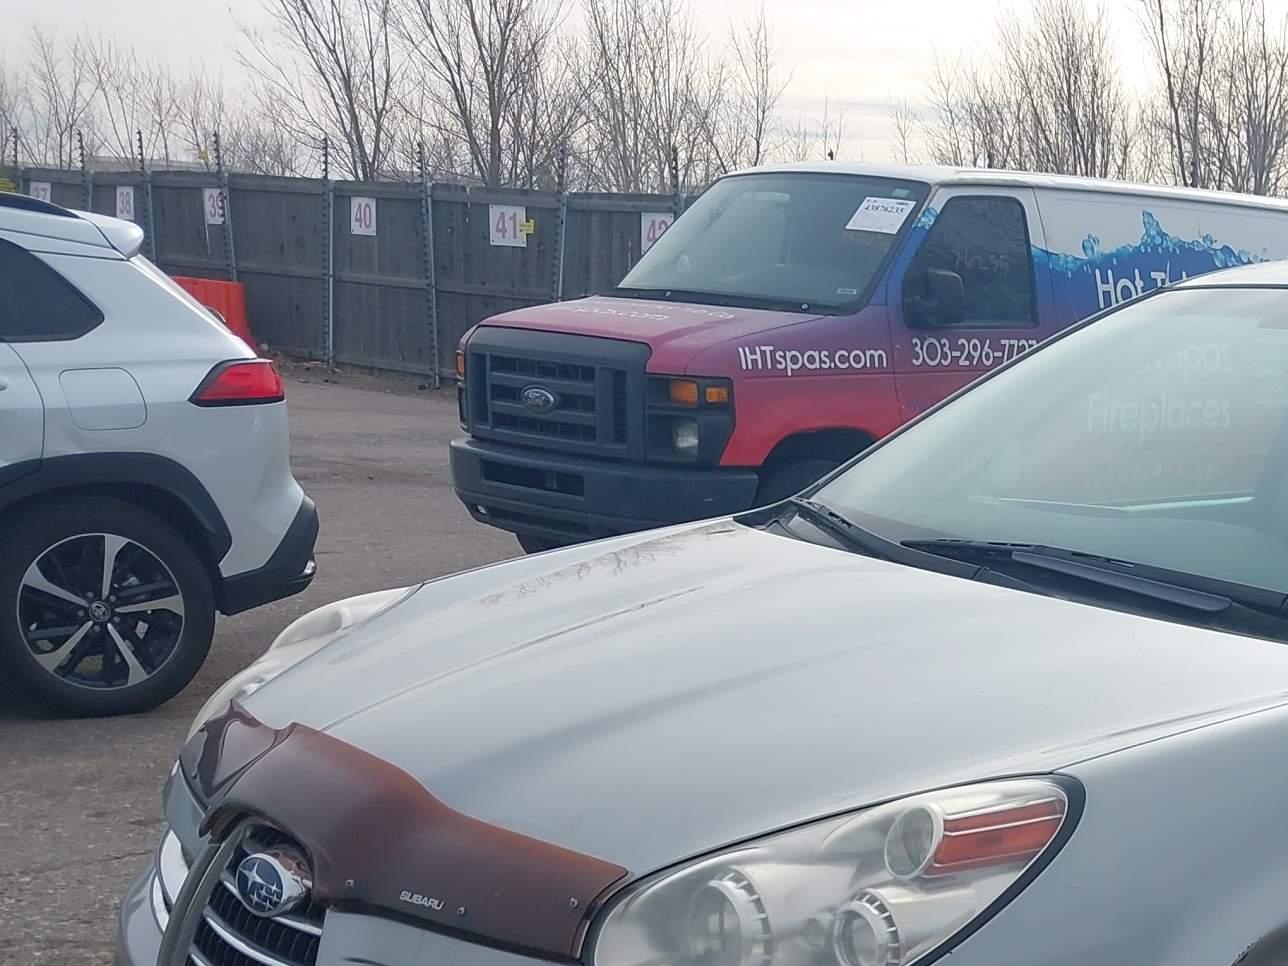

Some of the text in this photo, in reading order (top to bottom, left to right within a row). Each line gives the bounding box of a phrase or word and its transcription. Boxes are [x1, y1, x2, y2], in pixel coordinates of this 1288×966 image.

[119, 191, 131, 216] 38
[353, 203, 372, 230] 40
[495, 212, 518, 240] 41
[1094, 267, 1145, 309] Hot
[738, 345, 888, 376] IHTspas.com
[911, 337, 1038, 367] 303-296-77
[1087, 385, 1232, 444] Fireplaces
[399, 890, 445, 910] SUBARU
